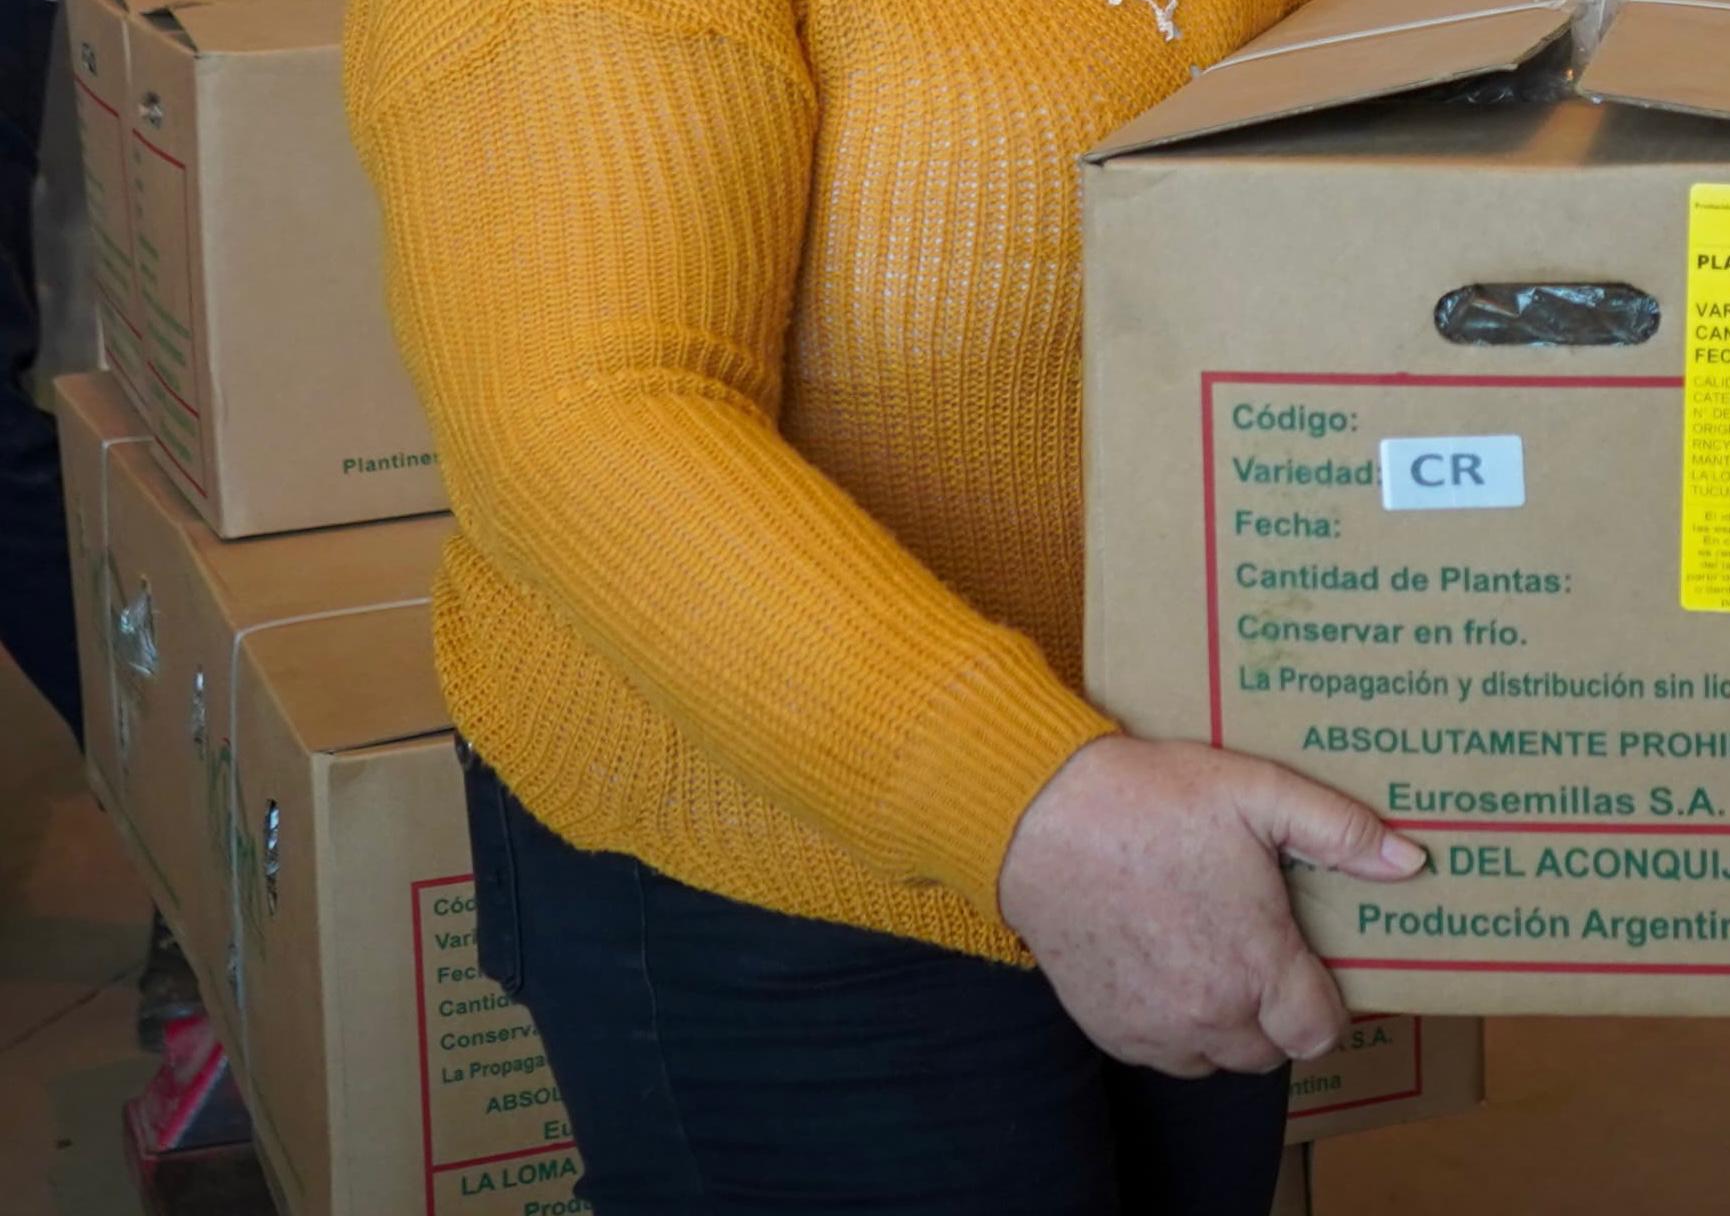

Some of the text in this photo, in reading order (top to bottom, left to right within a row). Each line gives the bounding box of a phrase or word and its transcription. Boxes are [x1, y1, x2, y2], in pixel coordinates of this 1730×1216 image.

[1231, 402, 1359, 439] Código:
[1712, 407, 1730, 419] DE
[1231, 456, 1383, 486] Variedad:
[1409, 453, 1486, 487] CR
[1691, 469, 1709, 482] LA
[1235, 509, 1342, 539] Fecha:
[1235, 561, 1573, 595] Cantidad de Plantas:
[1237, 614, 1528, 647] Conservar en frío.
[1239, 665, 1270, 692] La
[1278, 666, 1449, 703] Propagación
[1457, 677, 1474, 703] y
[1481, 672, 1647, 701] distribución
[1653, 673, 1695, 700] sin
[1302, 725, 1608, 758] ABSOLUTAMENTE
[1387, 782, 1727, 818] Eurosemillas S.A.
[1448, 845, 1526, 877] DEL
[1357, 902, 1569, 940] Producción
[437, 965, 481, 984] Fec
[1350, 1026, 1393, 1050] S.A.
[442, 1067, 464, 1083] La
[461, 1157, 577, 1196] LA LOMA
